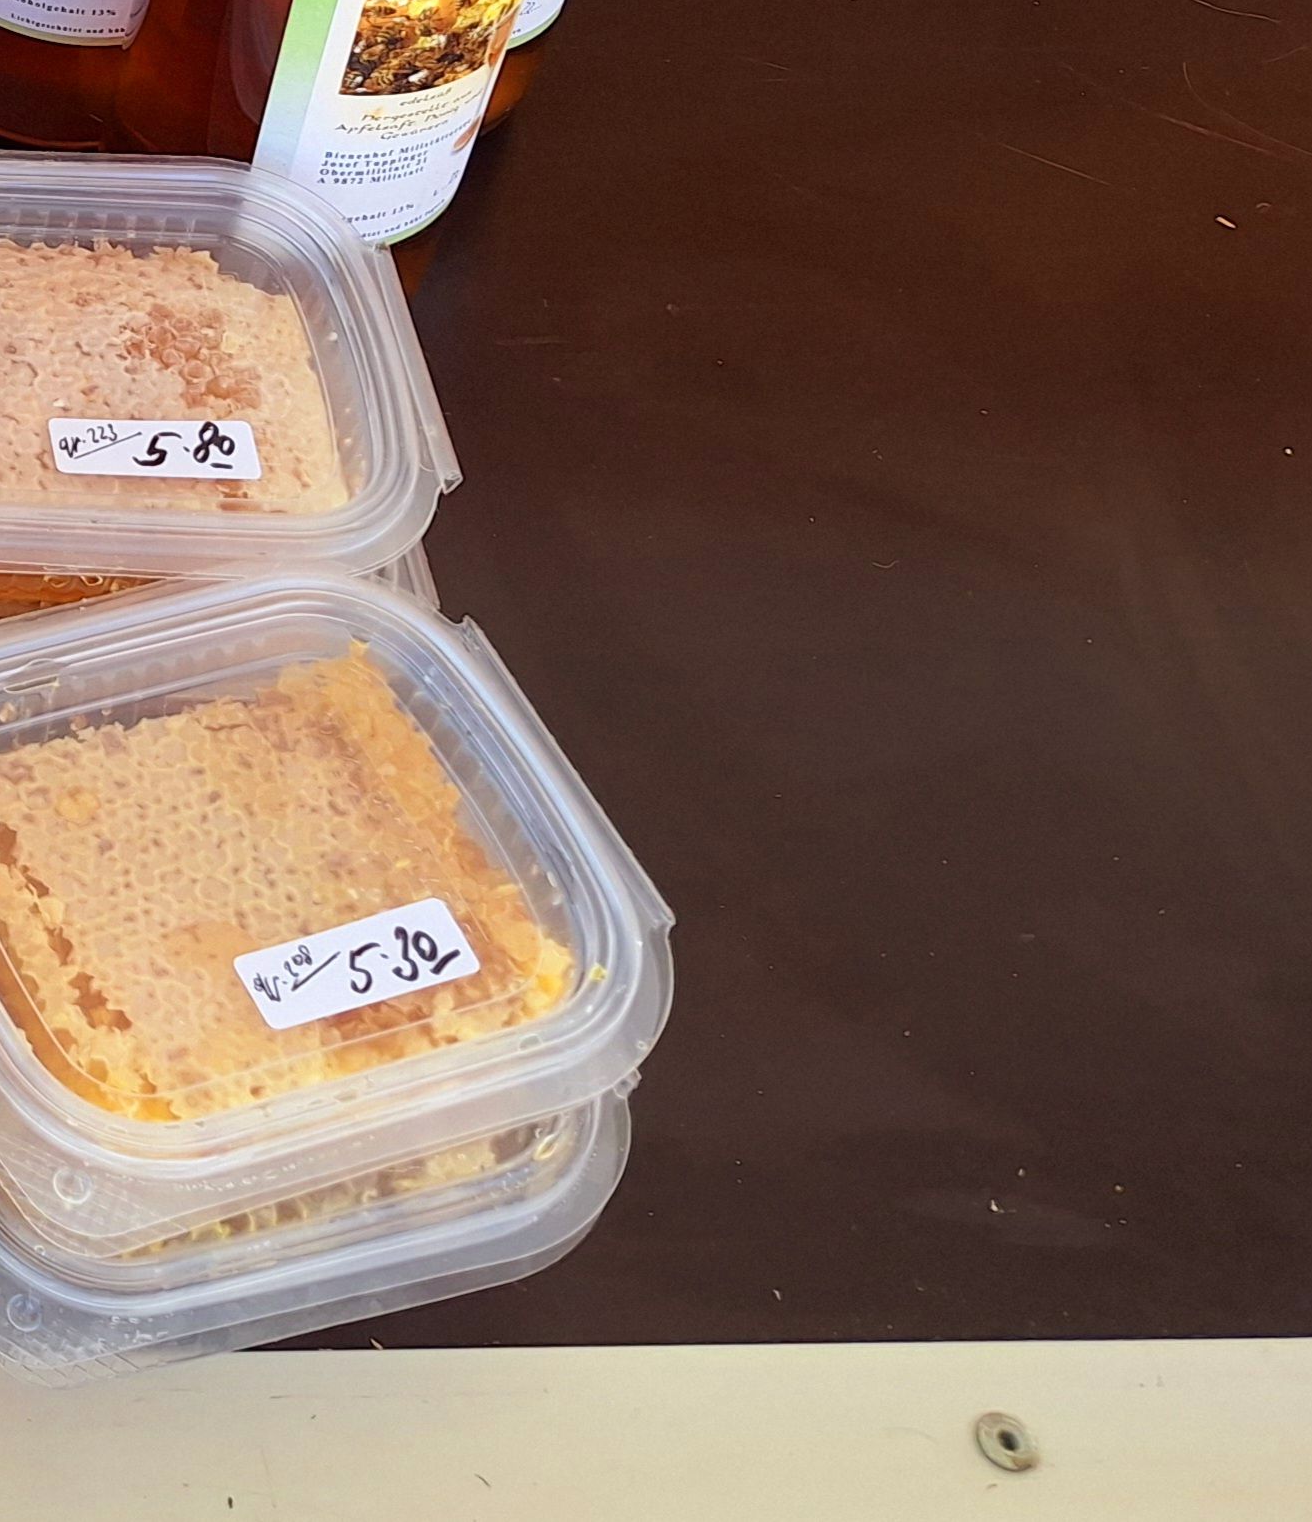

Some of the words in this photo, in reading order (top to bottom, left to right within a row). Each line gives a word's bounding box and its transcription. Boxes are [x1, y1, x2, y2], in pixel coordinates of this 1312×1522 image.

[325, 150, 395, 159] Bienenhof
[319, 163, 411, 176] Obermillstatt
[370, 166, 425, 183] Millstatt
[132, 421, 235, 467] 5.80
[349, 926, 439, 994] 5.30
